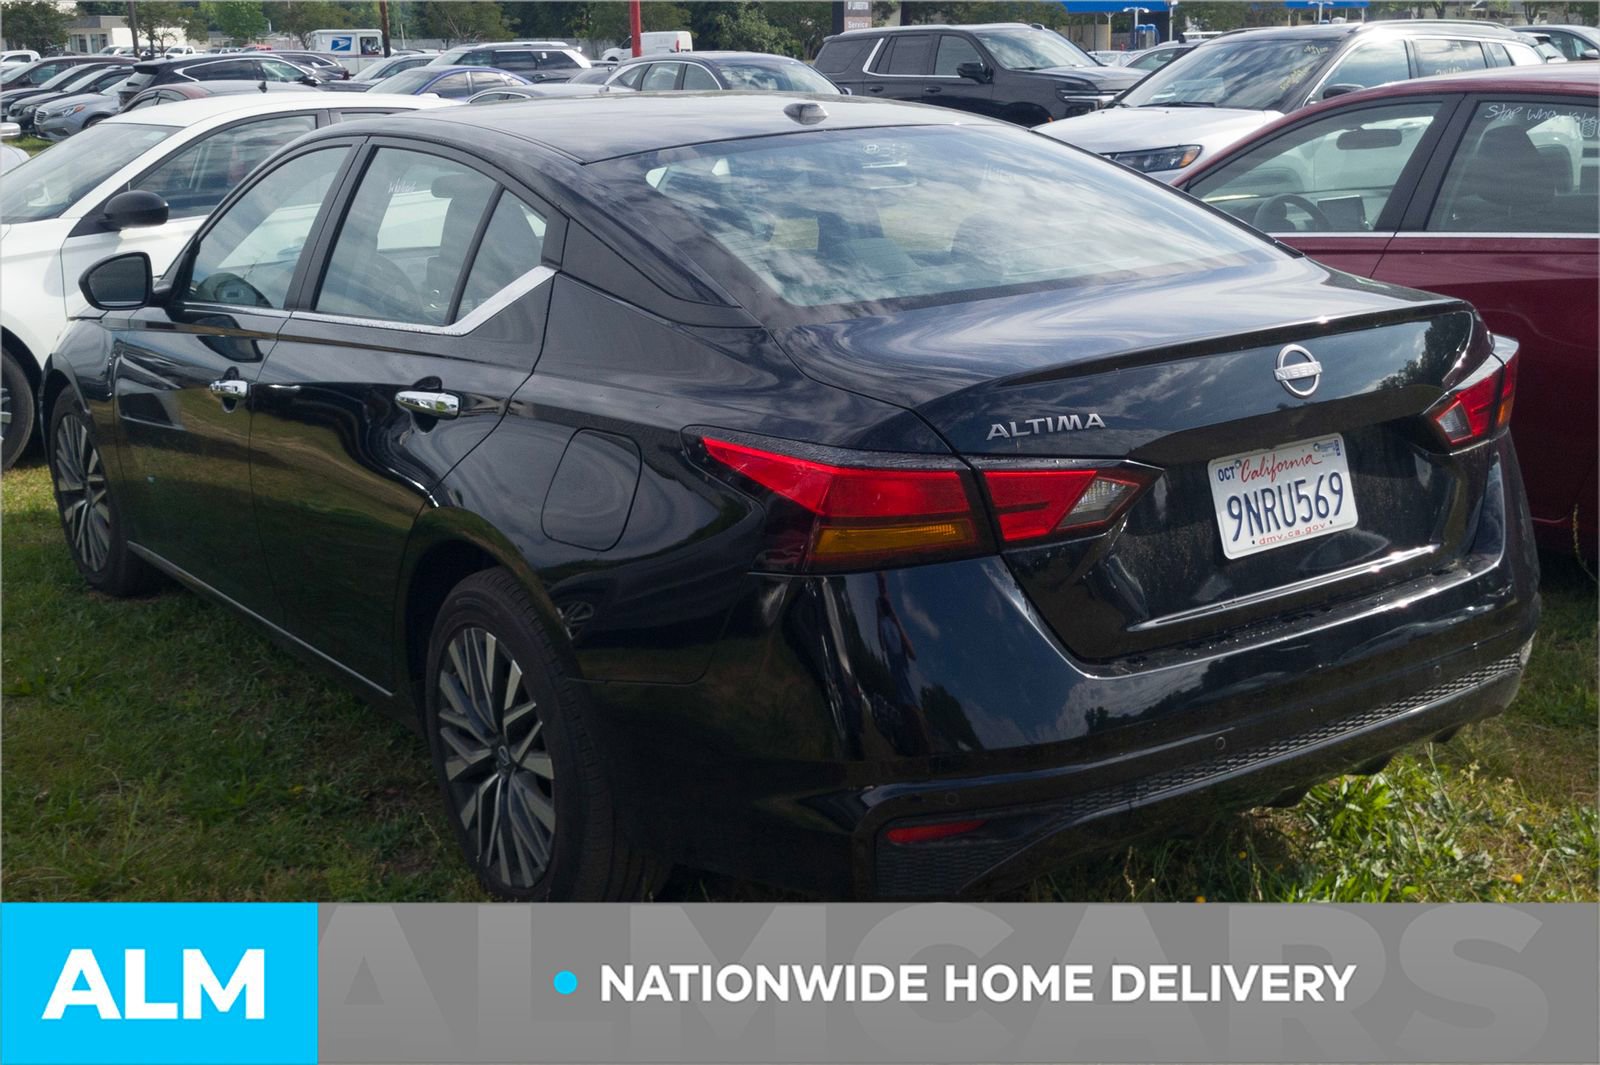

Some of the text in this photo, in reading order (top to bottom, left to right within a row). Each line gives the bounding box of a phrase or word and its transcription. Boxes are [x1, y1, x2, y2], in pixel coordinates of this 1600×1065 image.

[1274, 362, 1321, 380] NISSAN
[986, 413, 1106, 441] ALTIMA
[1218, 466, 1235, 482] OCT
[1240, 453, 1322, 483] California
[1227, 472, 1343, 542] 9NRU569
[1259, 523, 1326, 545] dmv.ca.gov
